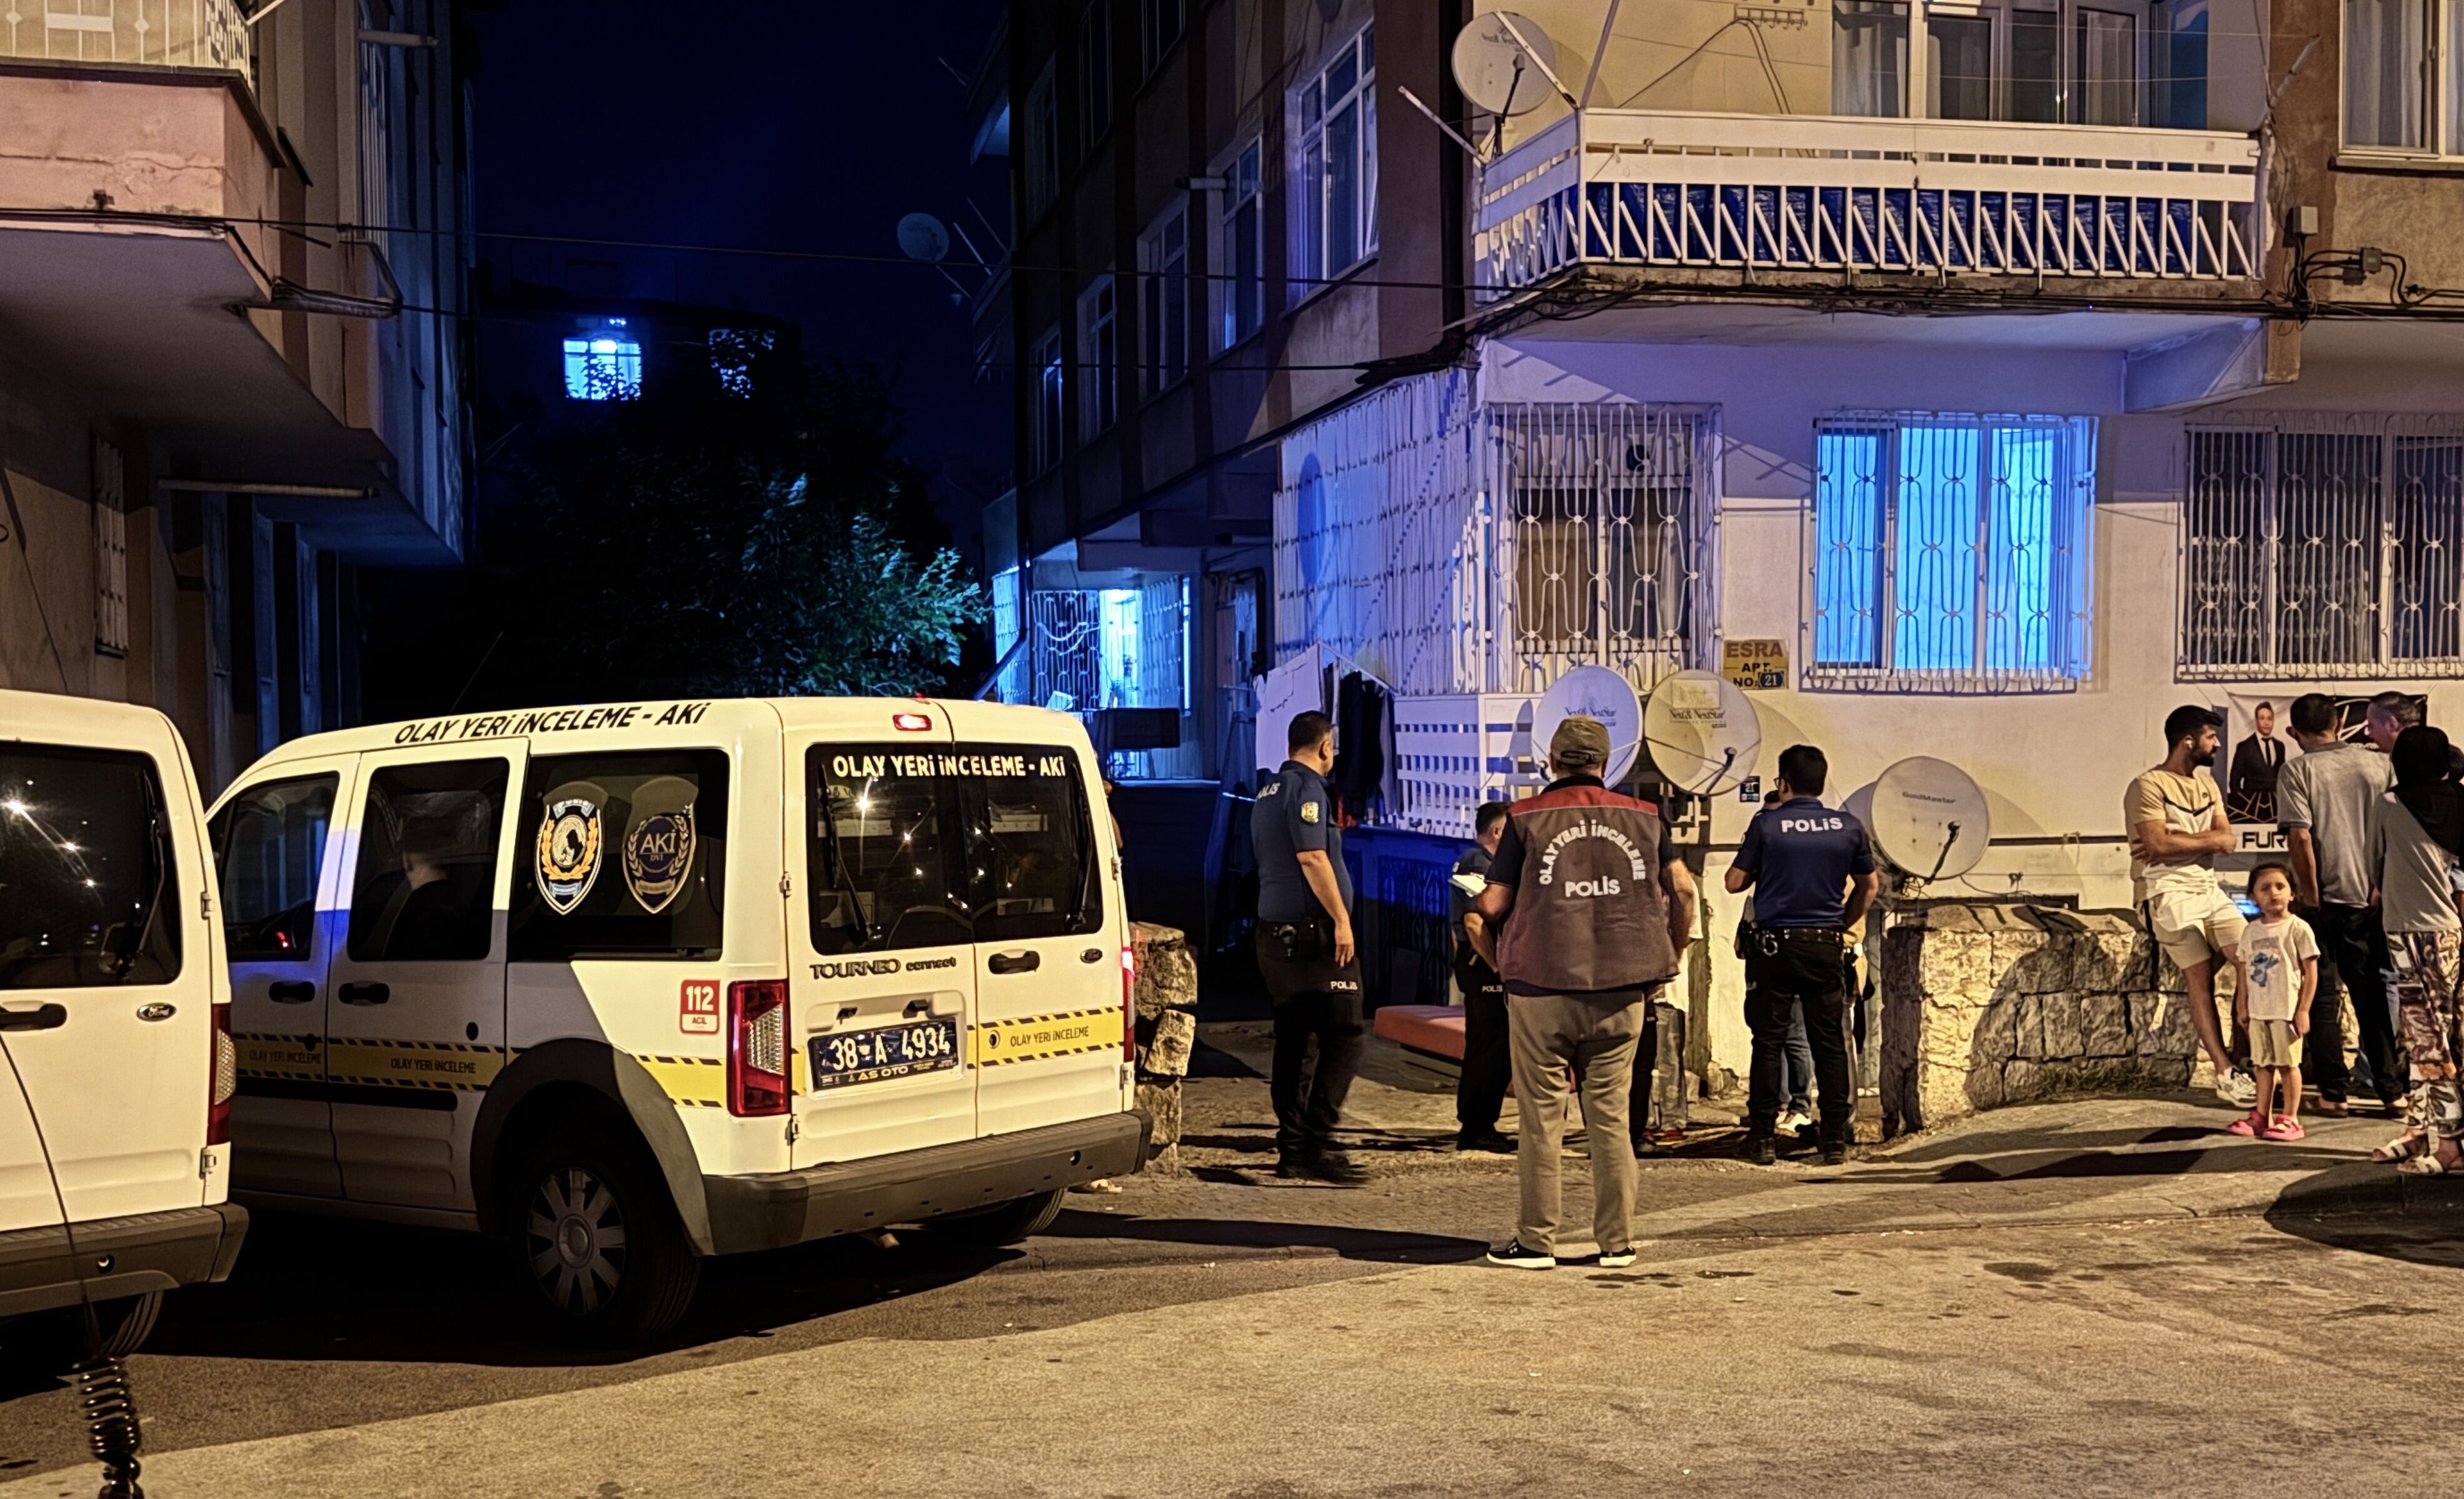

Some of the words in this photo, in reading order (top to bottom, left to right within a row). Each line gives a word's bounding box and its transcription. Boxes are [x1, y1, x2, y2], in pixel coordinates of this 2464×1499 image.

[1726, 642, 1783, 658] ESRA
[1764, 675, 1778, 686] 21
[394, 720, 461, 744] OLAY
[833, 755, 886, 777] OLAY
[1539, 842, 1559, 885] OLAY
[810, 959, 901, 979] TOURNEO
[906, 957, 957, 971] connect
[686, 986, 714, 1011] 112
[830, 1037, 858, 1070] 38
[875, 1034, 888, 1064] A
[902, 1026, 950, 1060] 4934
[1010, 1034, 1031, 1047] OLAY
[391, 1058, 412, 1069] OLAY
[858, 1070, 878, 1081] AS
[881, 1066, 908, 1077] OTO
